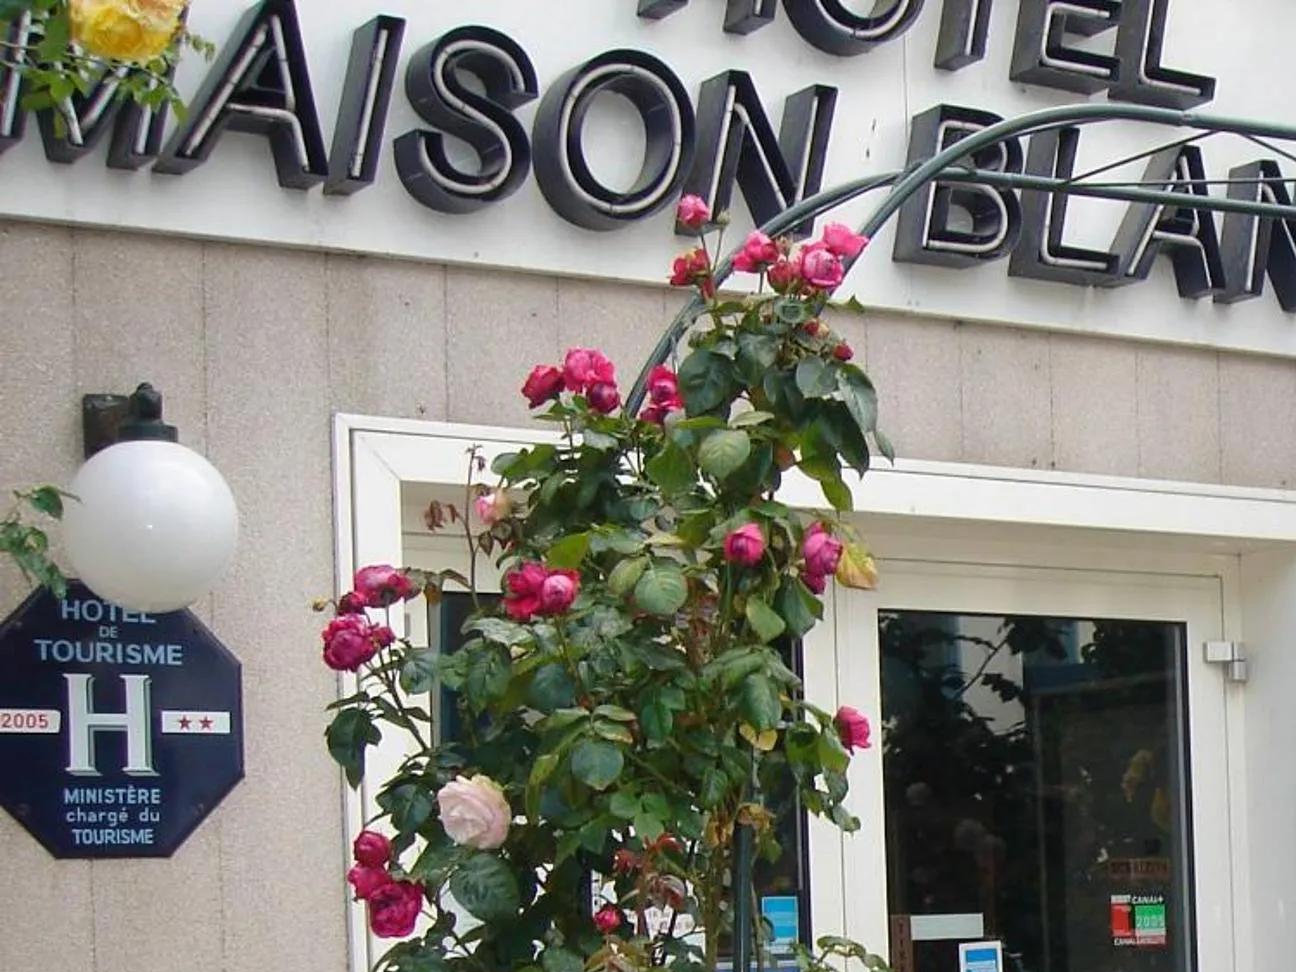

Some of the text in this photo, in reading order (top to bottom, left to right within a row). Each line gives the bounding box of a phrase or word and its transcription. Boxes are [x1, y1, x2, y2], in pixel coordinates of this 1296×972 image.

[0, 0, 838, 239] MAISON
[99, 625, 118, 638] DE
[34, 639, 183, 665] TOURISME
[1, 712, 49, 728] 2005
[62, 673, 160, 776] H
[66, 807, 160, 827] chargé du
[72, 829, 153, 844] TOURISME
